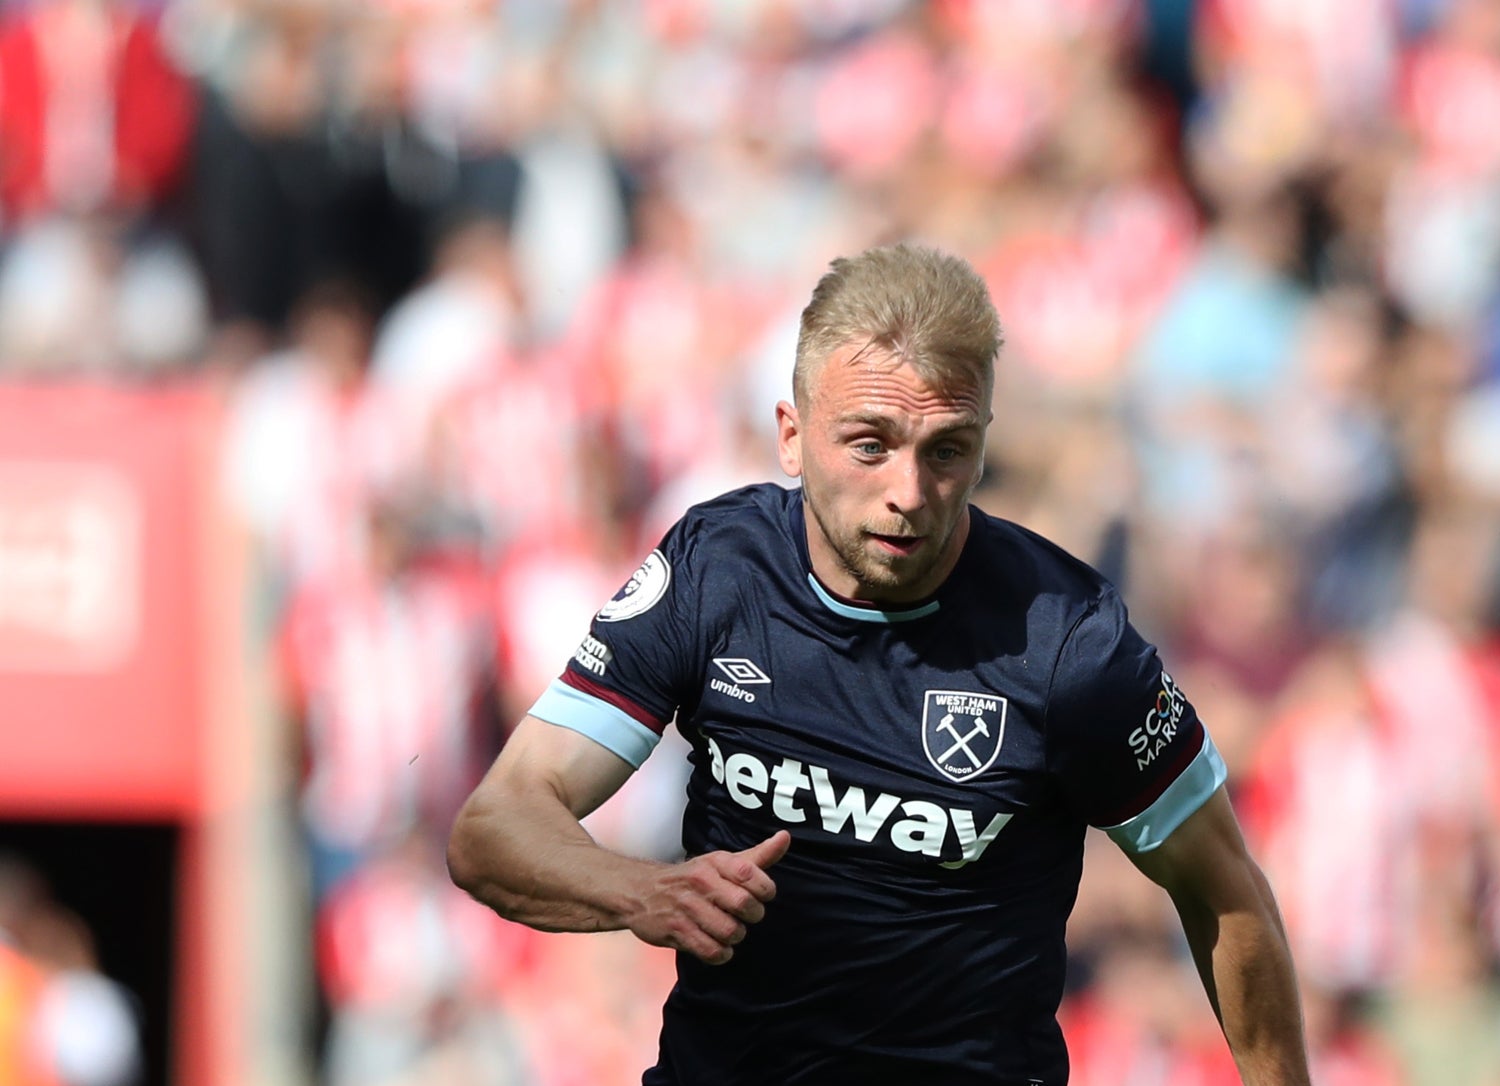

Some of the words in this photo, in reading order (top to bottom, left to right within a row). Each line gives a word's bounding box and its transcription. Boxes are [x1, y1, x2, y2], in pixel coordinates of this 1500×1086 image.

[710, 678, 756, 703] umbro
[935, 694, 967, 706] WEST
[968, 697, 997, 712] HAM
[947, 704, 984, 716] UNITED
[944, 763, 973, 774] LONDON
